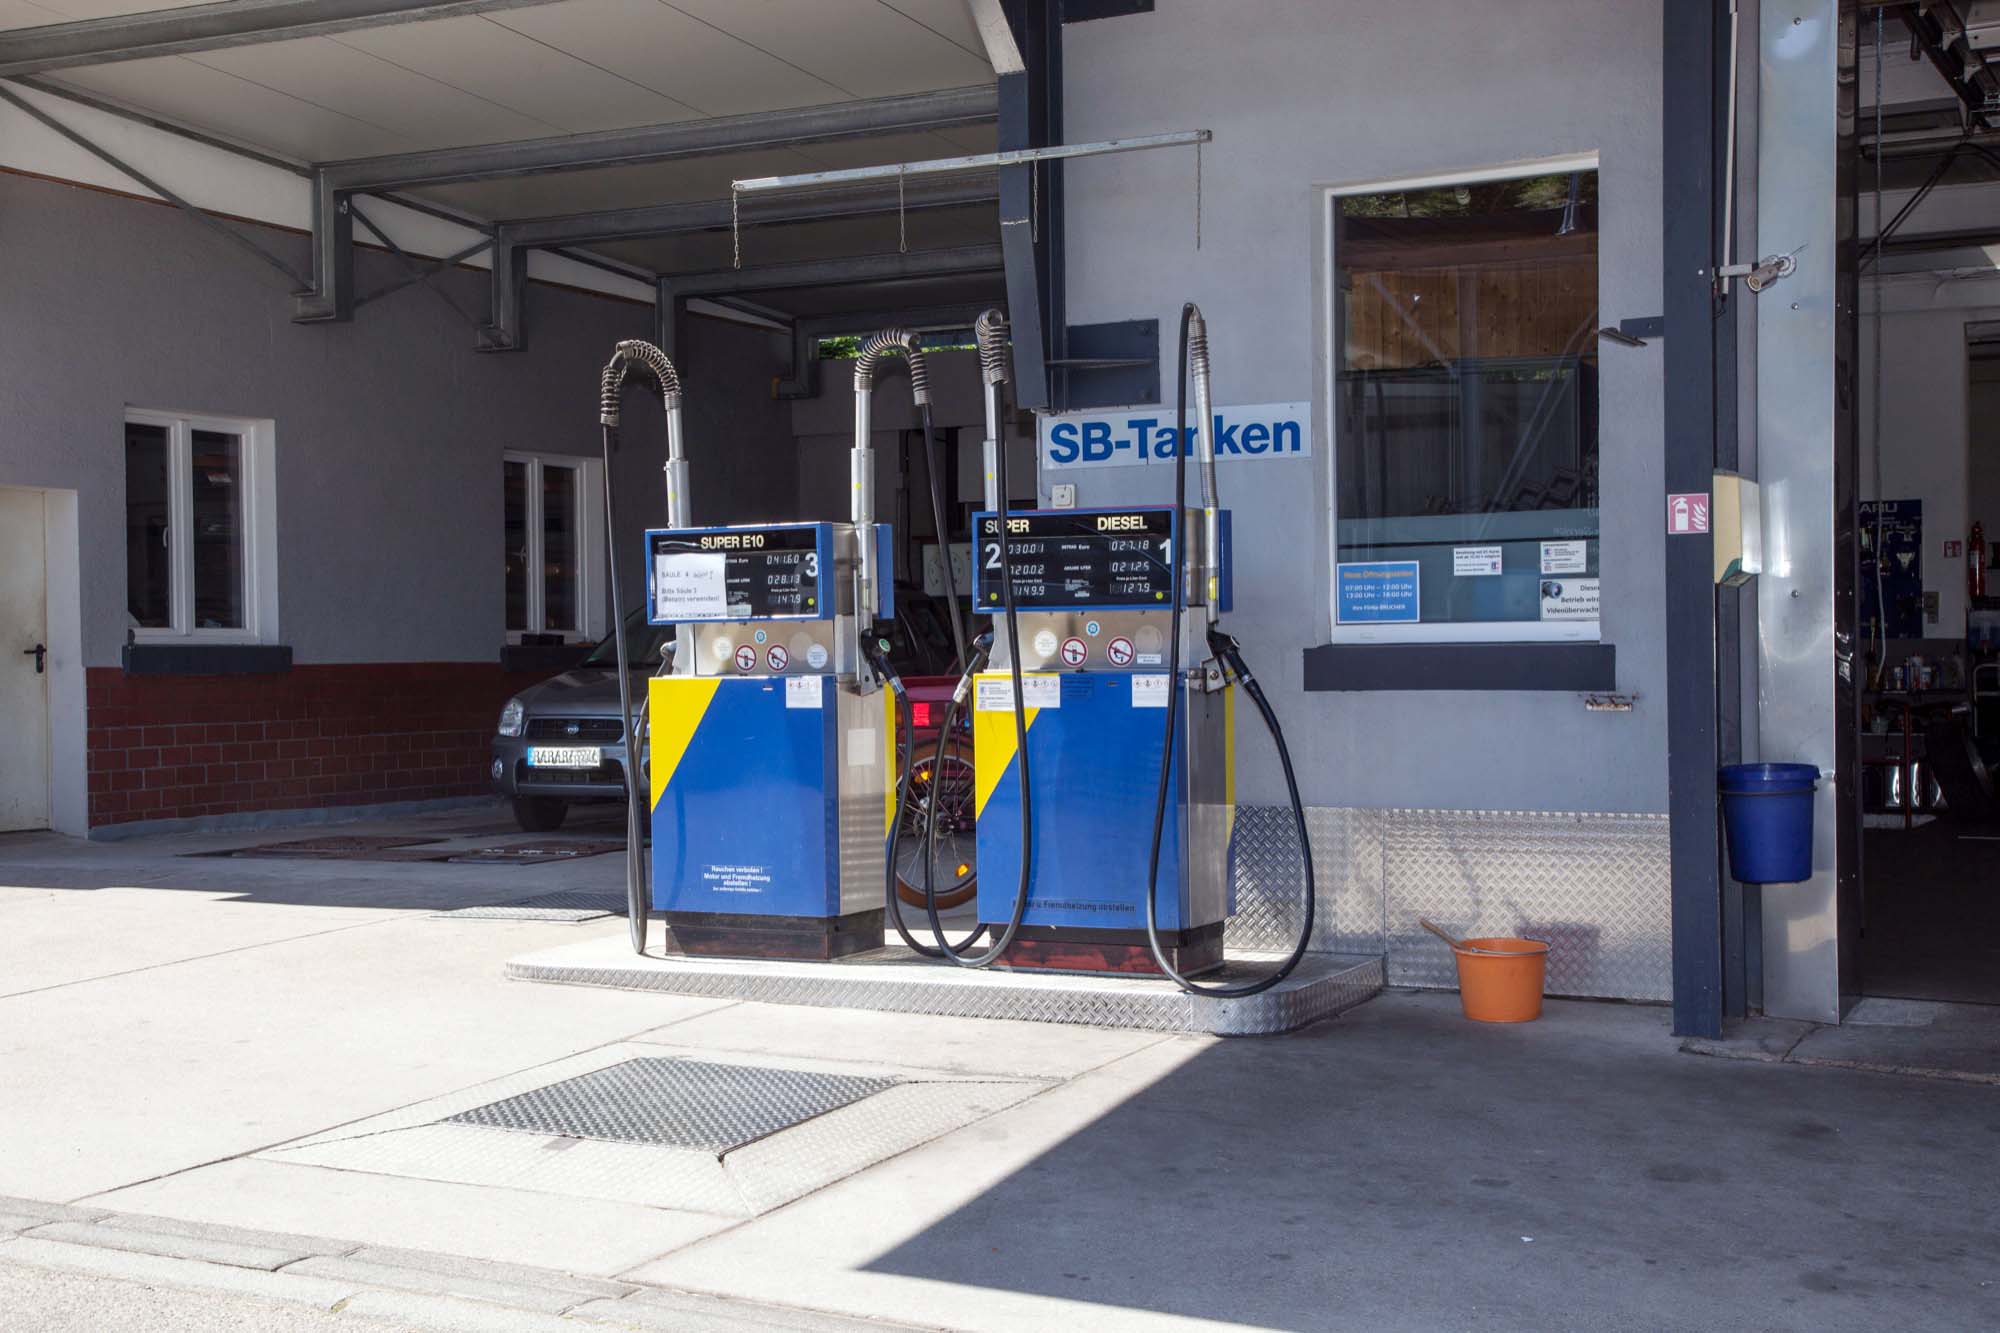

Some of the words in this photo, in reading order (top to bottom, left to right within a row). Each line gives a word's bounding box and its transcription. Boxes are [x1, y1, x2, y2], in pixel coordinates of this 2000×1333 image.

[1097, 516, 1147, 530] DIESEL
[700, 535, 740, 549] SUPER
[742, 534, 764, 548] E10
[1159, 538, 1171, 565] 1
[805, 552, 818, 577] 3
[985, 542, 1002, 569] 2
